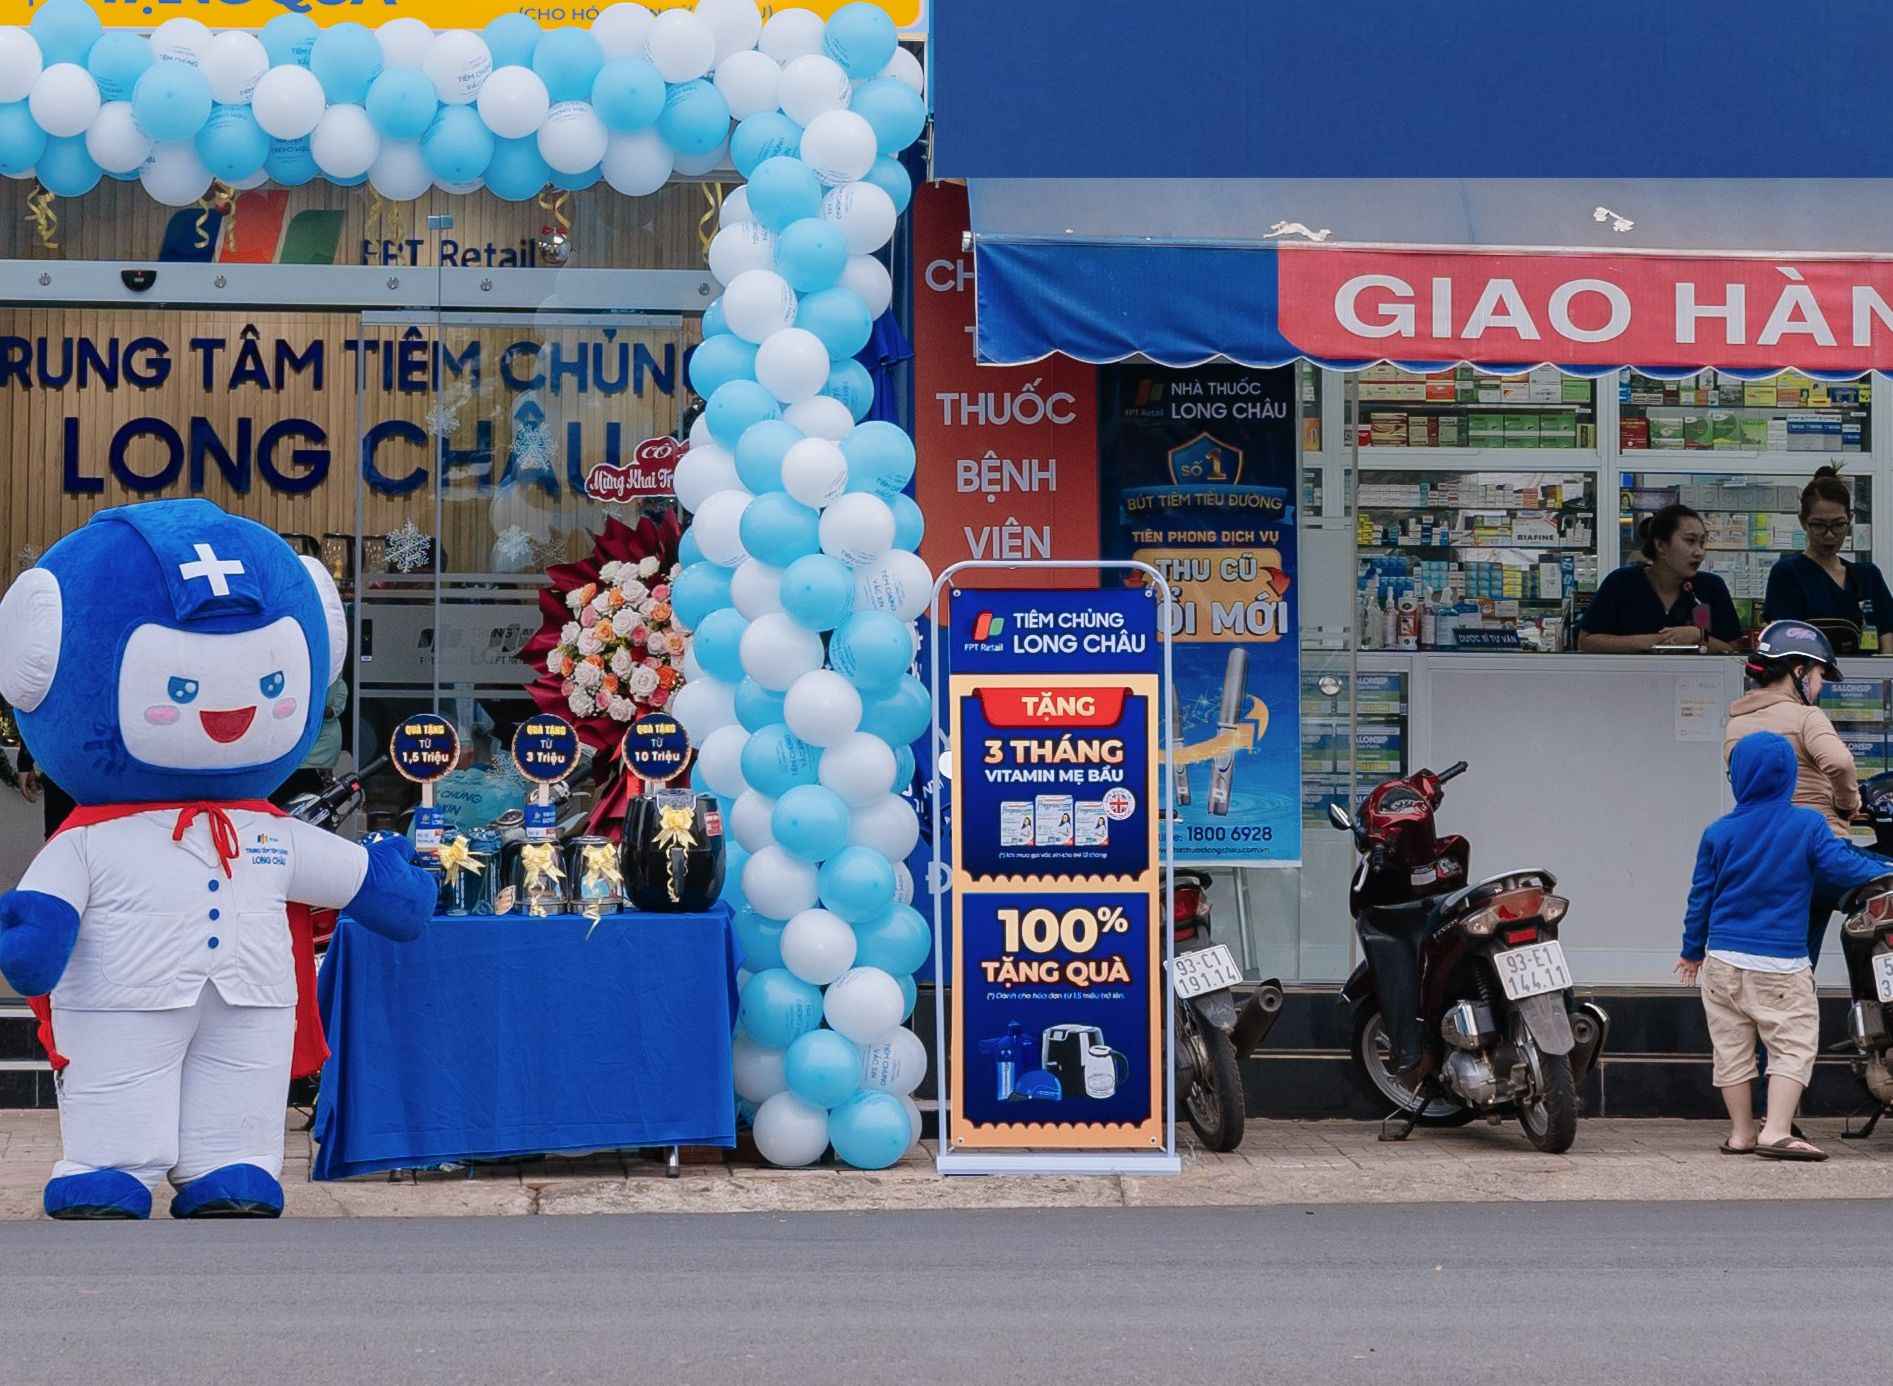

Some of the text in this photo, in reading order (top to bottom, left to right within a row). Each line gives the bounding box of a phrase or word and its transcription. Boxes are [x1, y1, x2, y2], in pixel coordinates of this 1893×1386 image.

[1332, 274, 1633, 343] GIAO
[189, 324, 325, 391] TÂM
[344, 324, 481, 393] TIÊM
[1171, 377, 1261, 395] NHÀ THUỐC
[935, 378, 1076, 426] THUỐC
[1171, 399, 1287, 419] LONG CHÂU
[62, 400, 623, 496] LONG CHÂU
[956, 450, 1057, 503] BỆNH
[1168, 531, 1217, 542] PHONG
[1211, 592, 1288, 635] MỚI
[1021, 691, 1095, 721] TẶNG
[421, 751, 449, 764] Triệu
[526, 752, 534, 762] 3
[635, 751, 648, 761] 10
[1009, 734, 1124, 764] THÁNG
[985, 769, 1055, 782] VITAMIN
[1186, 827, 1226, 841] 1800
[1231, 827, 1272, 841] 6928
[998, 907, 1128, 953] 100%
[981, 956, 1130, 988] TẶNG QUÀ
[1176, 951, 1221, 976] 93-C1
[1504, 948, 1553, 973] 93-E1
[1179, 966, 1236, 995] 191.14
[1507, 966, 1567, 996] 144.11
